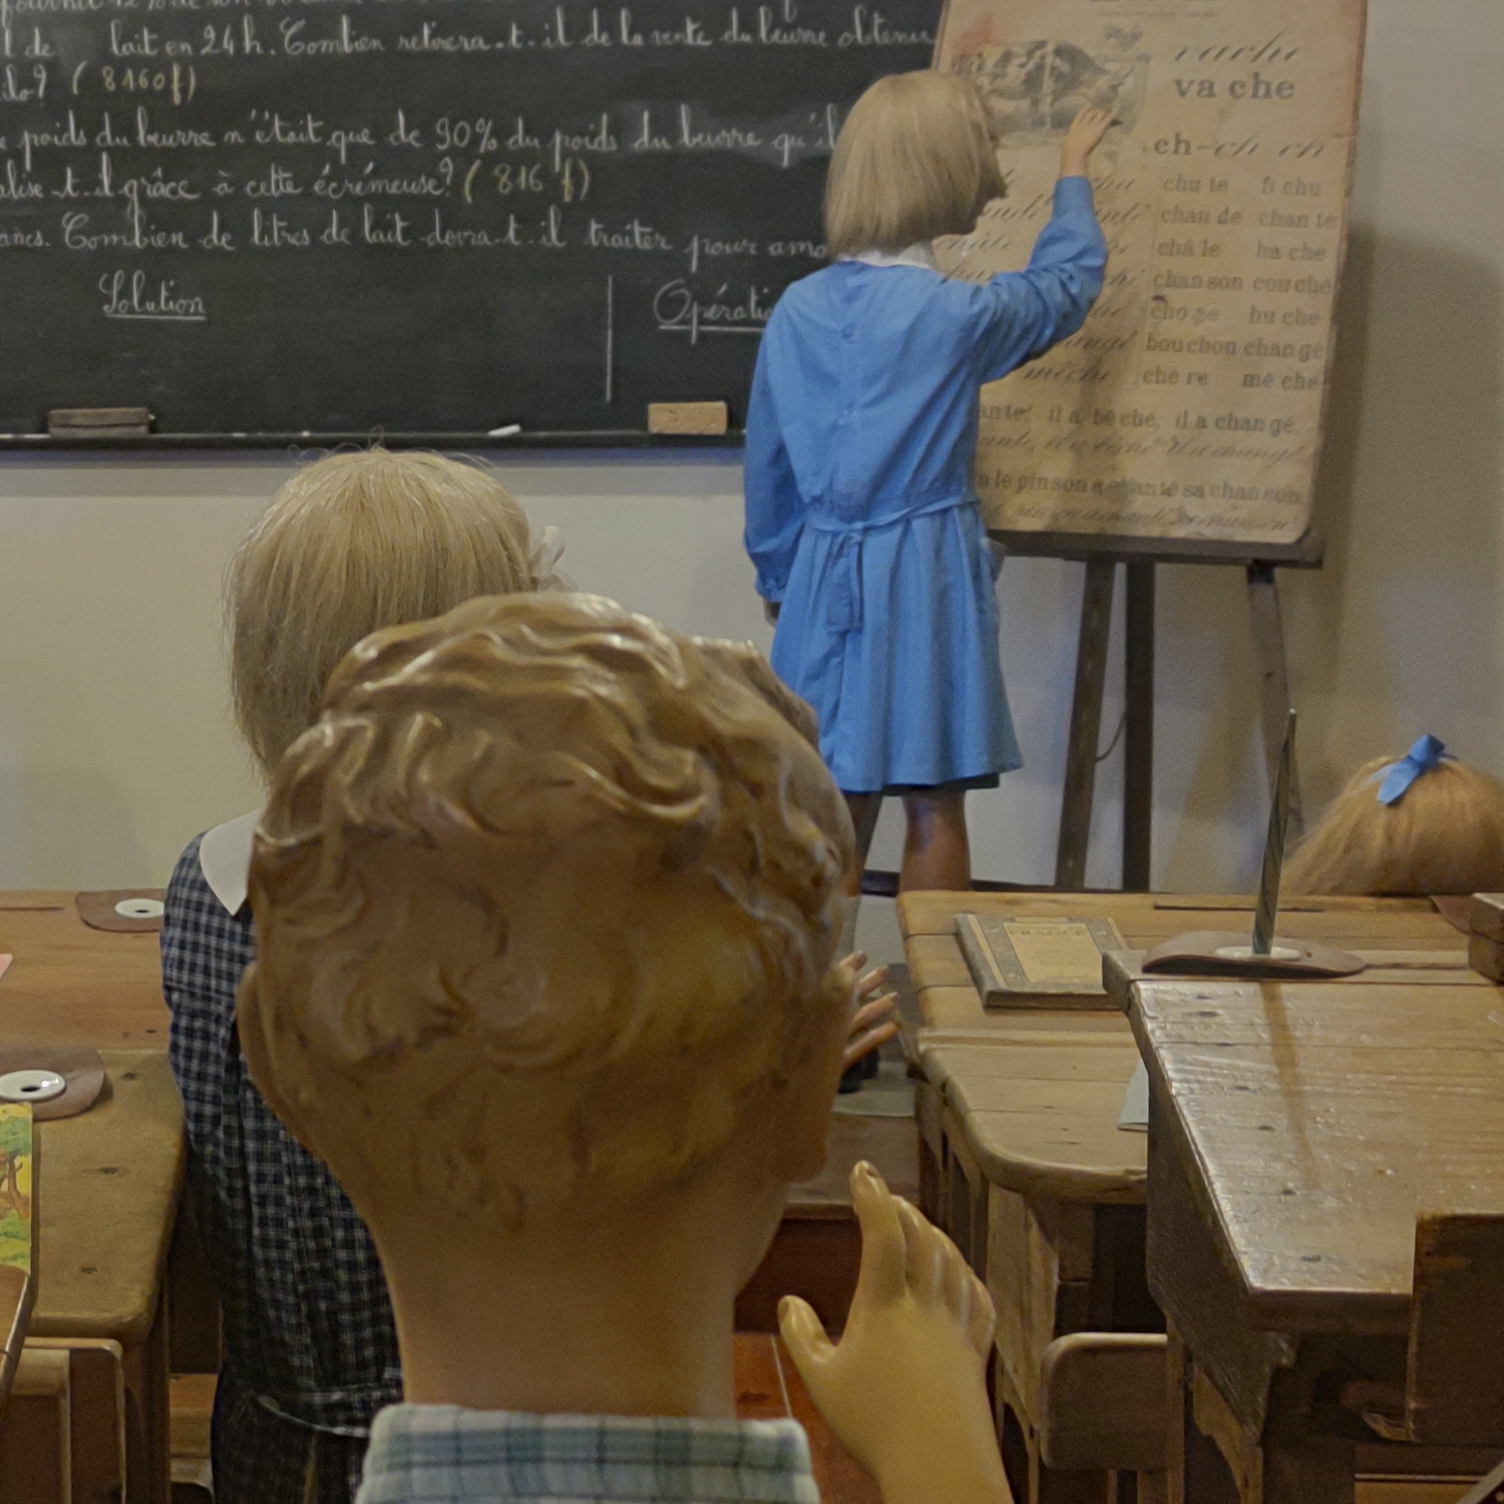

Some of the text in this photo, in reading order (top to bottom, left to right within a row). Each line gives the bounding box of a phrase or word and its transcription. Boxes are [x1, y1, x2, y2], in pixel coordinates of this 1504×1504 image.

[23, 26, 57, 58] de
[109, 18, 162, 57] lait
[165, 39, 193, 57] en
[278, 13, 385, 56] Combien
[580, 5, 614, 47] de
[618, 5, 644, 47] la
[646, 16, 712, 47] vente
[717, 5, 753, 47] du
[757, 3, 830, 45] beurre
[16, 108, 87, 172] poids
[95, 111, 131, 148] du
[135, 105, 216, 148] beurre
[326, 129, 377, 165] que
[389, 107, 423, 147] de
[504, 115, 541, 148] du
[553, 113, 618, 174] poids
[632, 108, 673, 149] du
[680, 103, 762, 148] beurre
[211, 170, 236, 195] à
[245, 163, 304, 195] cette
[61, 209, 191, 249] Combien
[198, 209, 236, 250] de
[253, 205, 311, 246] litres
[319, 208, 353, 245] de
[365, 202, 412, 246] lait
[588, 217, 673, 251] traiter
[684, 234, 759, 274] pour
[97, 268, 206, 315] Solution
[652, 278, 773, 345] Opérati
